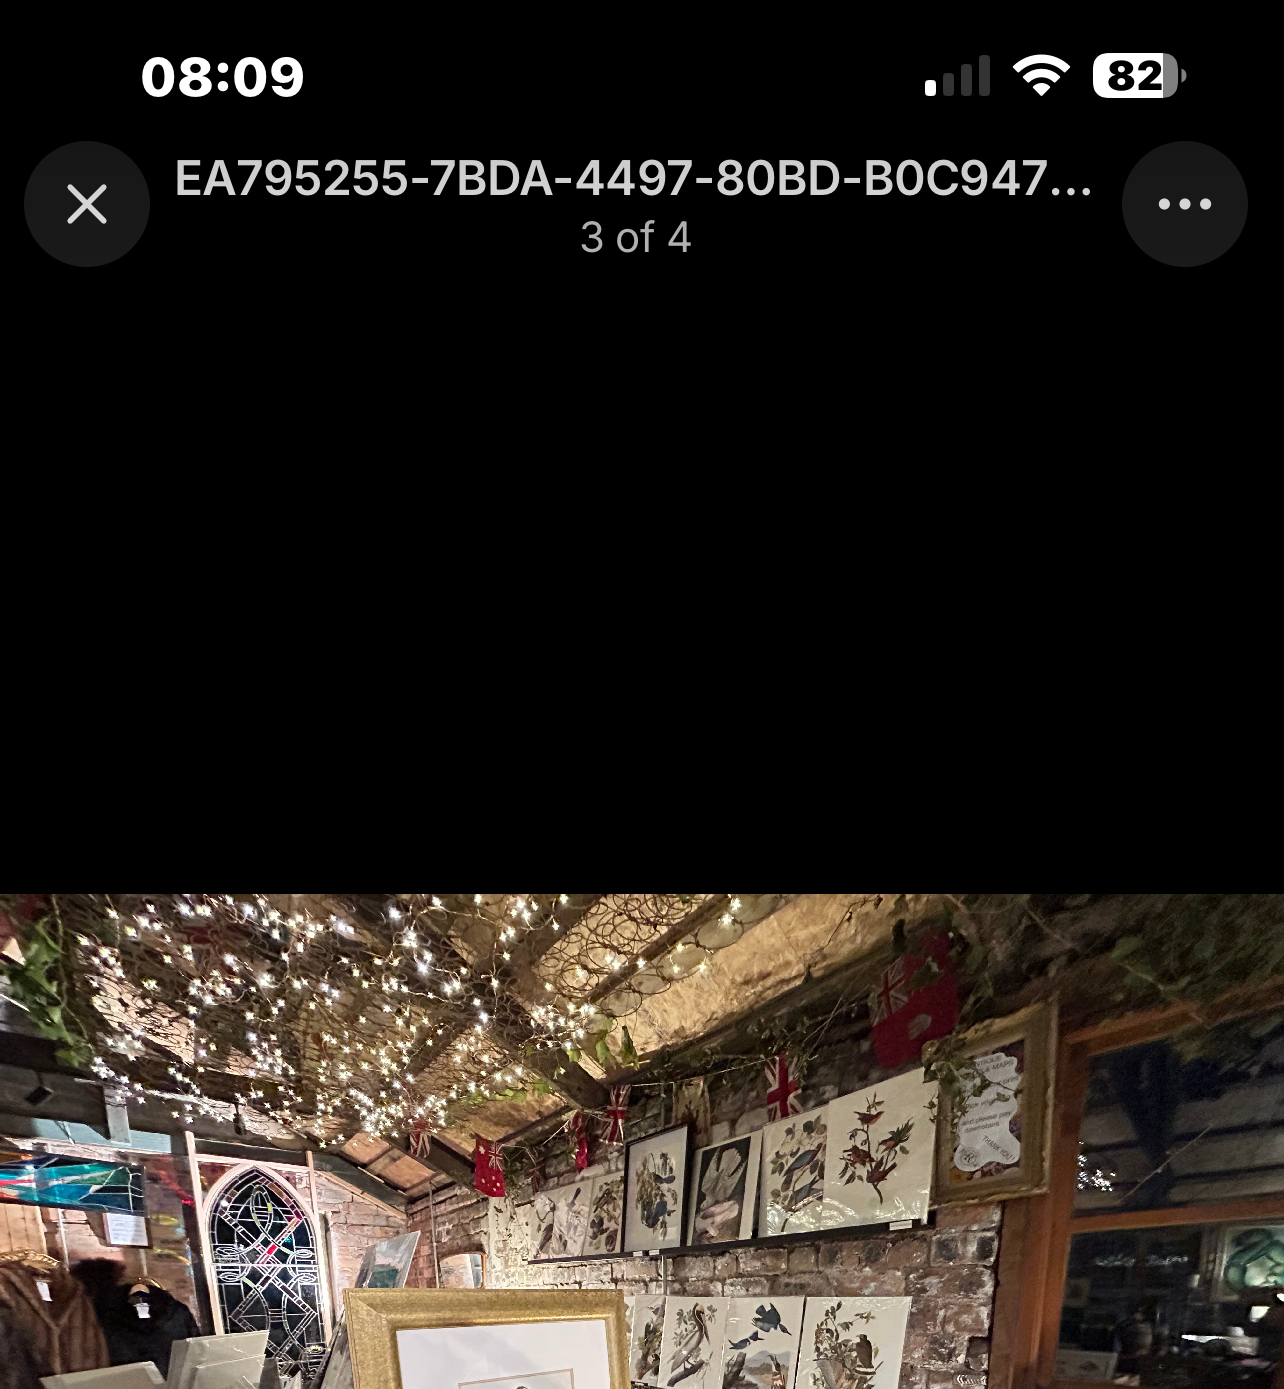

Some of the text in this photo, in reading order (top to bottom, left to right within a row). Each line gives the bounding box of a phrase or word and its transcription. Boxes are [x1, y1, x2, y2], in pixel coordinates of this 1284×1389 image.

[141, 56, 304, 98] 08:09
[1107, 59, 1163, 92] 82
[581, 219, 692, 254] 3 of 4
[982, 1135, 1001, 1152] THANK
